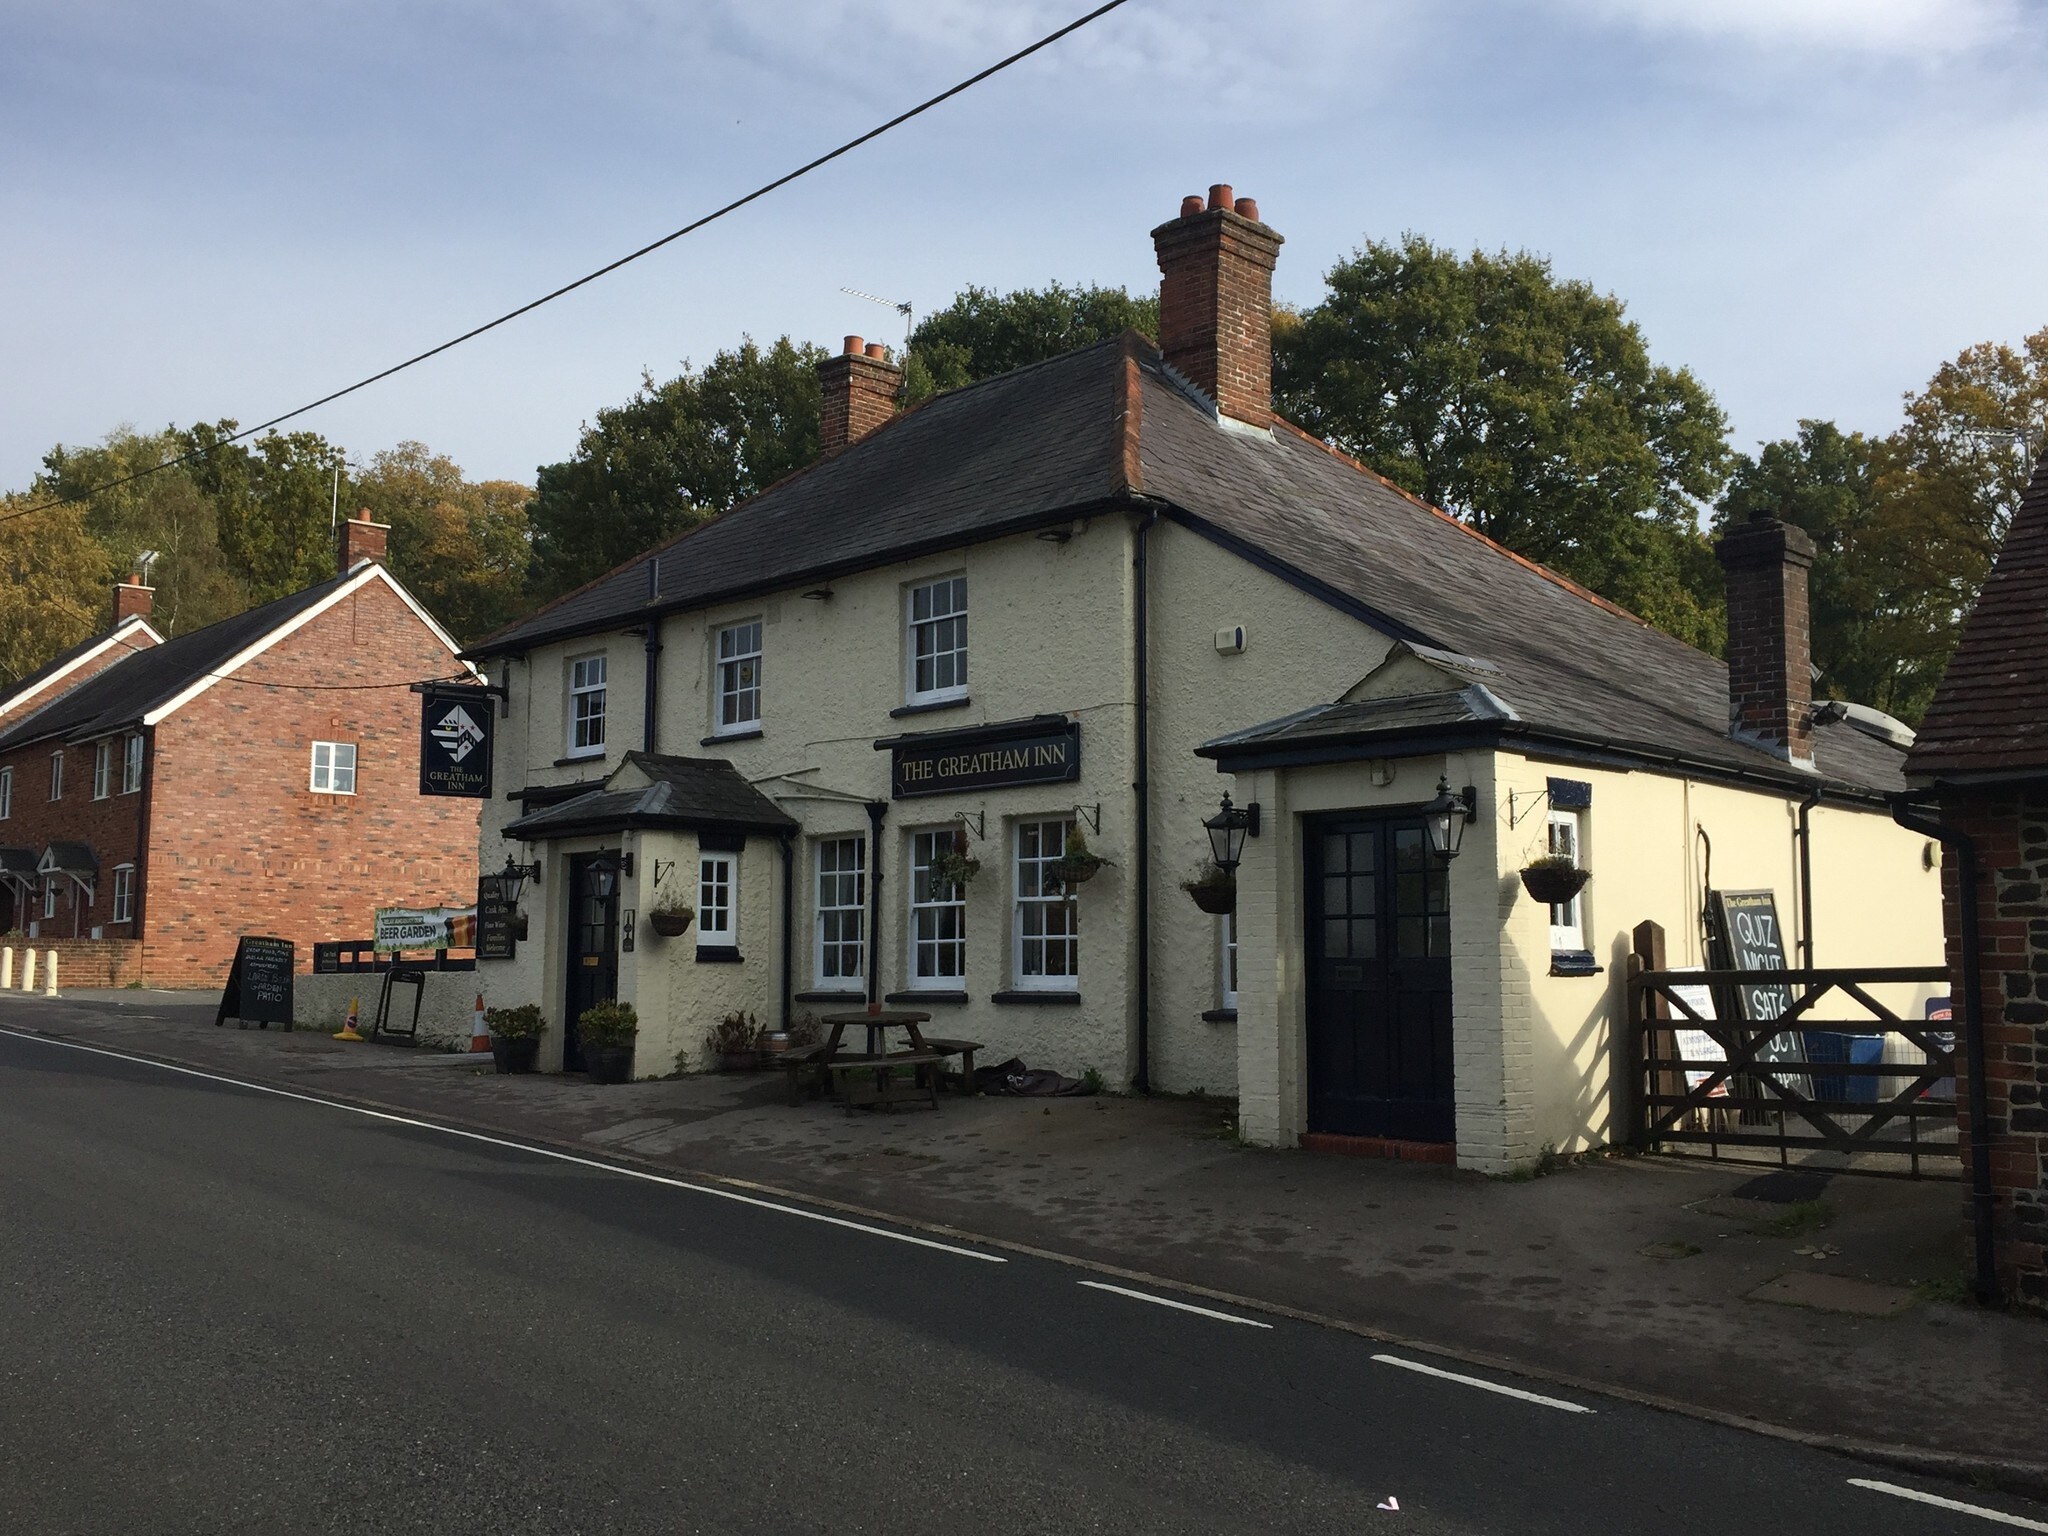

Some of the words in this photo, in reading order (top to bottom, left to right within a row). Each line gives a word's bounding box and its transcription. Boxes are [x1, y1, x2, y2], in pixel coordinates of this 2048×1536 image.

[902, 760, 933, 782] THE
[937, 748, 1029, 778] GREATHAM
[1034, 743, 1066, 767] INN
[450, 765, 463, 773] THE
[429, 771, 483, 783] GREATHAM
[447, 781, 465, 790] INN
[380, 926, 399, 940] BEER
[400, 925, 436, 939] GARDEN
[1736, 911, 1778, 949] QUIZ
[250, 981, 283, 993] GARDEN
[256, 991, 283, 1002] PATIO
[1752, 989, 1778, 1020] SAT
